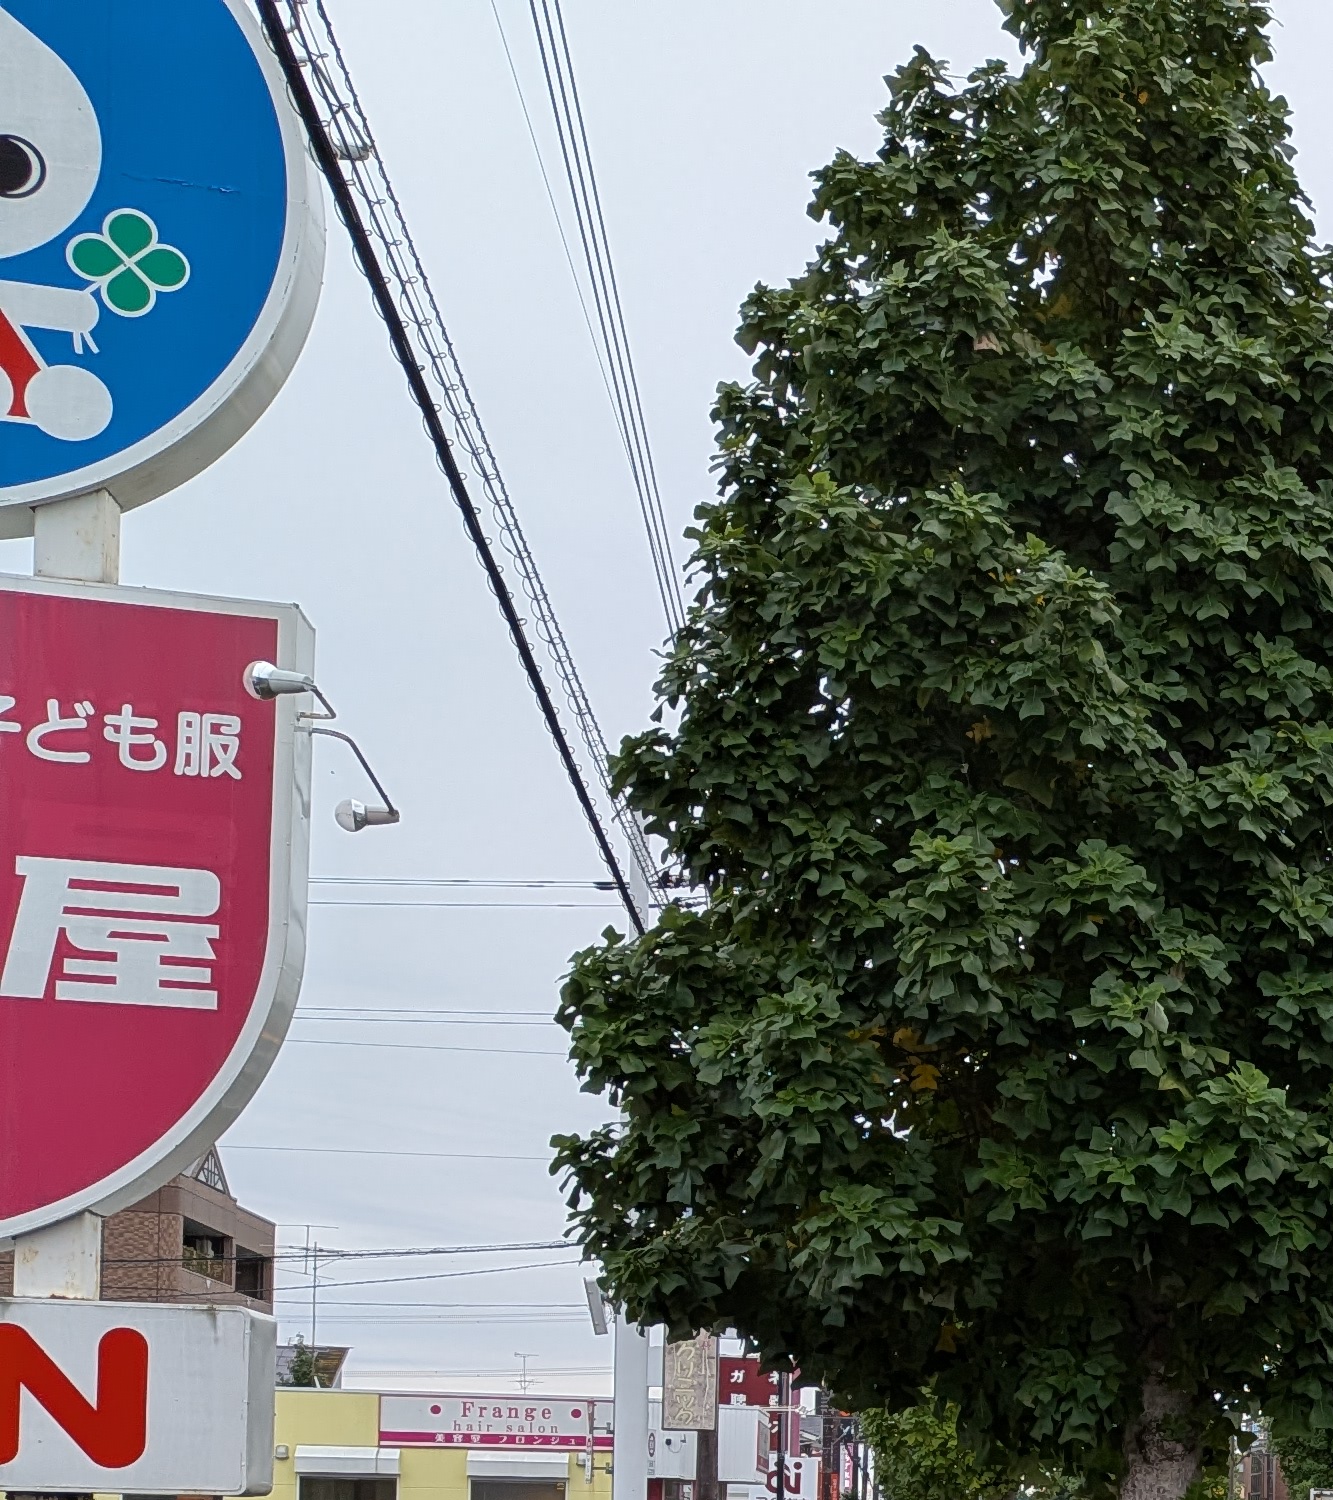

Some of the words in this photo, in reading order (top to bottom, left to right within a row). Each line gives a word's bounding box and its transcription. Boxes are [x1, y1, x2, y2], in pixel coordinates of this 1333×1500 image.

[0, 856, 221, 1010] 屋
[461, 1401, 551, 1421] Frange
[453, 1420, 493, 1433] hair
[506, 1422, 559, 1434] salon
